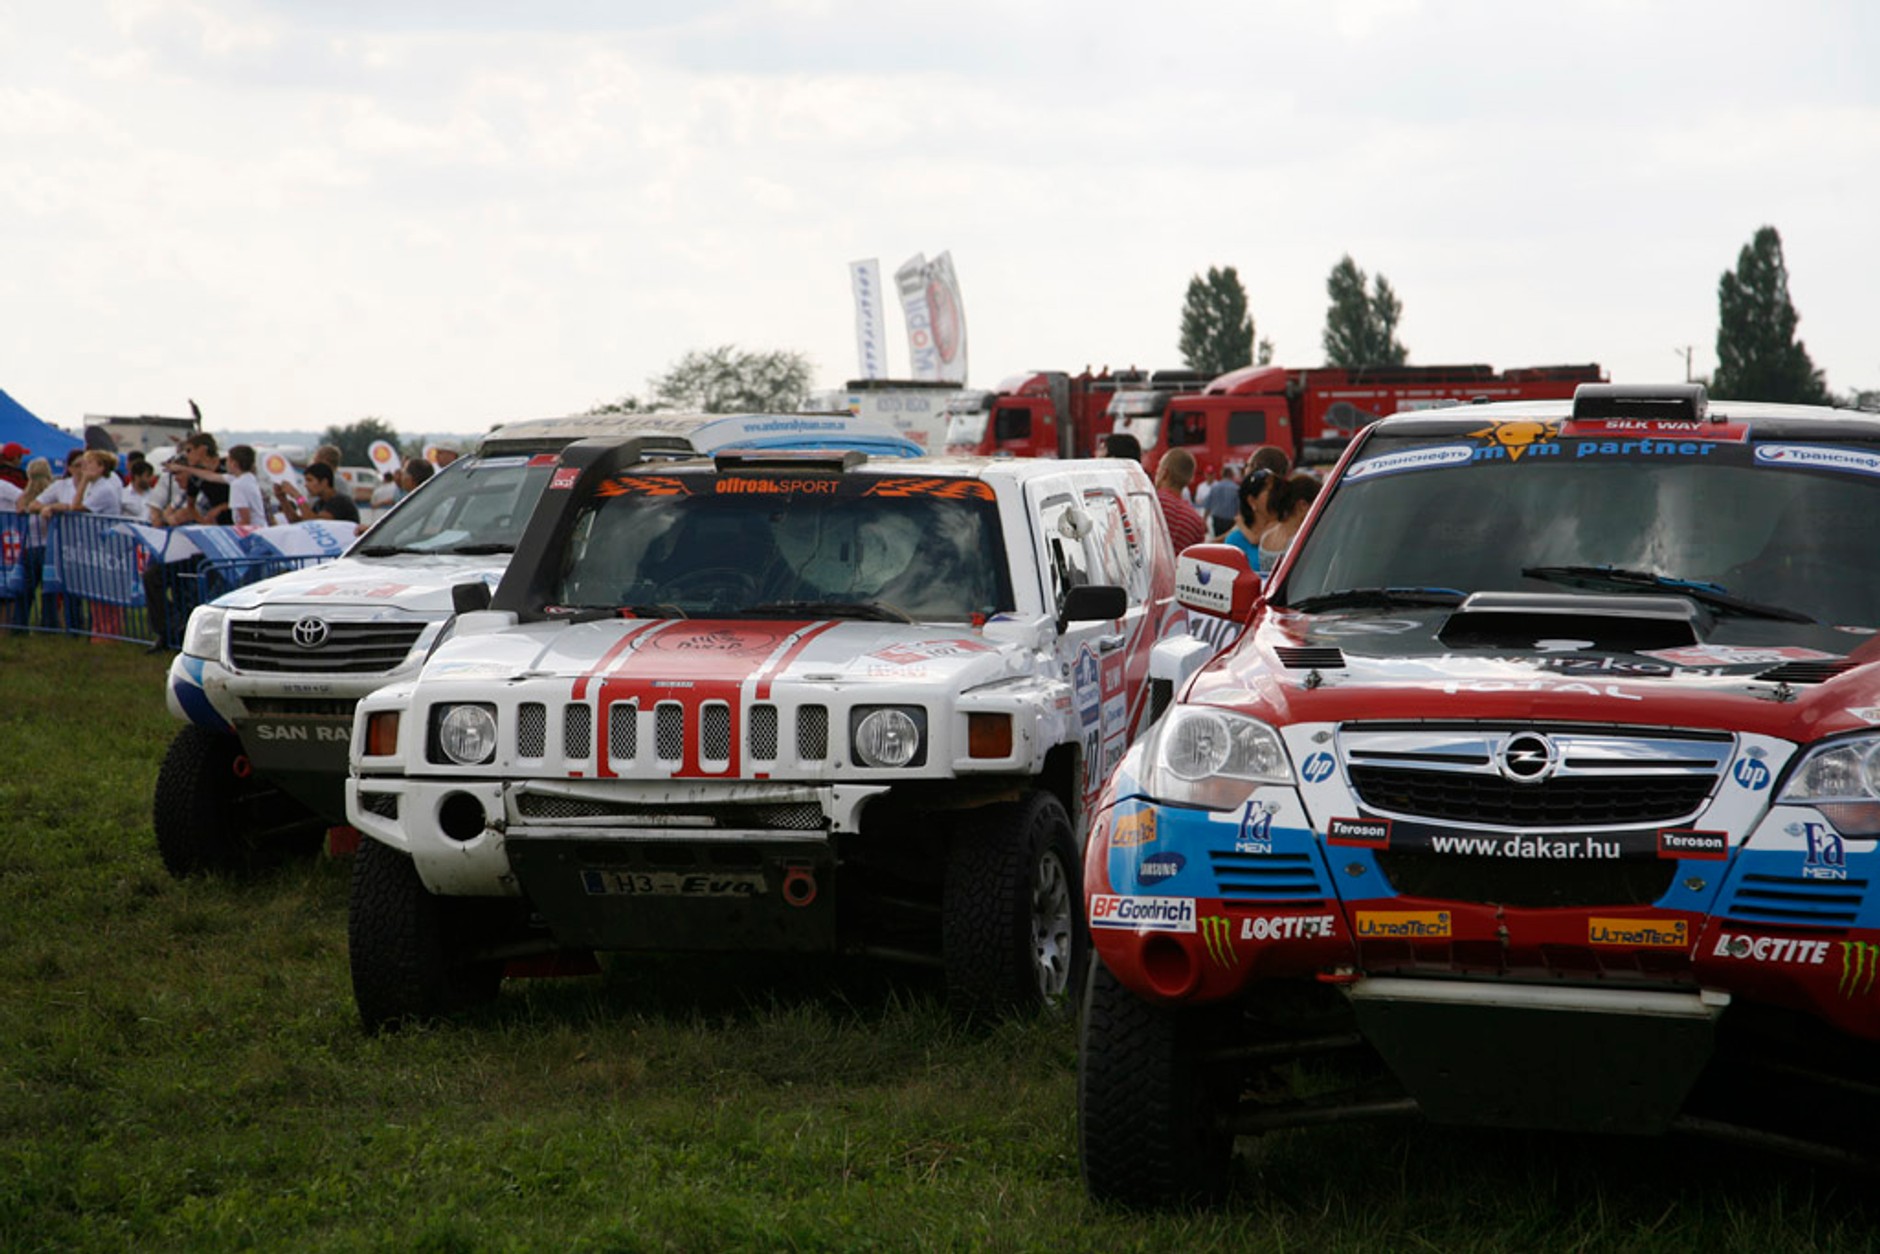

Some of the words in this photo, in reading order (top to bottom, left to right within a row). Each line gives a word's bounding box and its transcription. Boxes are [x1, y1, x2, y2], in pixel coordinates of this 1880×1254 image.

[1605, 421, 1648, 430] SILK
[1657, 422, 1702, 431] WAY
[1370, 448, 1467, 469] Транснефть
[1472, 443, 1560, 461] mvm
[1576, 438, 1717, 456] partner
[1789, 449, 1880, 467] Транснеф
[1430, 678, 1643, 700] TOTAL
[256, 724, 308, 741] SAN
[316, 725, 353, 741] RA
[1304, 752, 1333, 783] hp
[1736, 758, 1769, 790] hp
[1238, 800, 1273, 842] Fa
[1333, 822, 1386, 837] Teroson
[1235, 843, 1273, 854] MEN
[1432, 836, 1621, 859] www.dakar.hu
[1663, 834, 1723, 848] Teroson
[1804, 822, 1846, 867] Fa
[1802, 867, 1847, 880] MEN
[1093, 898, 1192, 921] BFGoodrich
[1241, 916, 1335, 939] LOCTITE
[1713, 934, 1831, 964] LOCTITE
